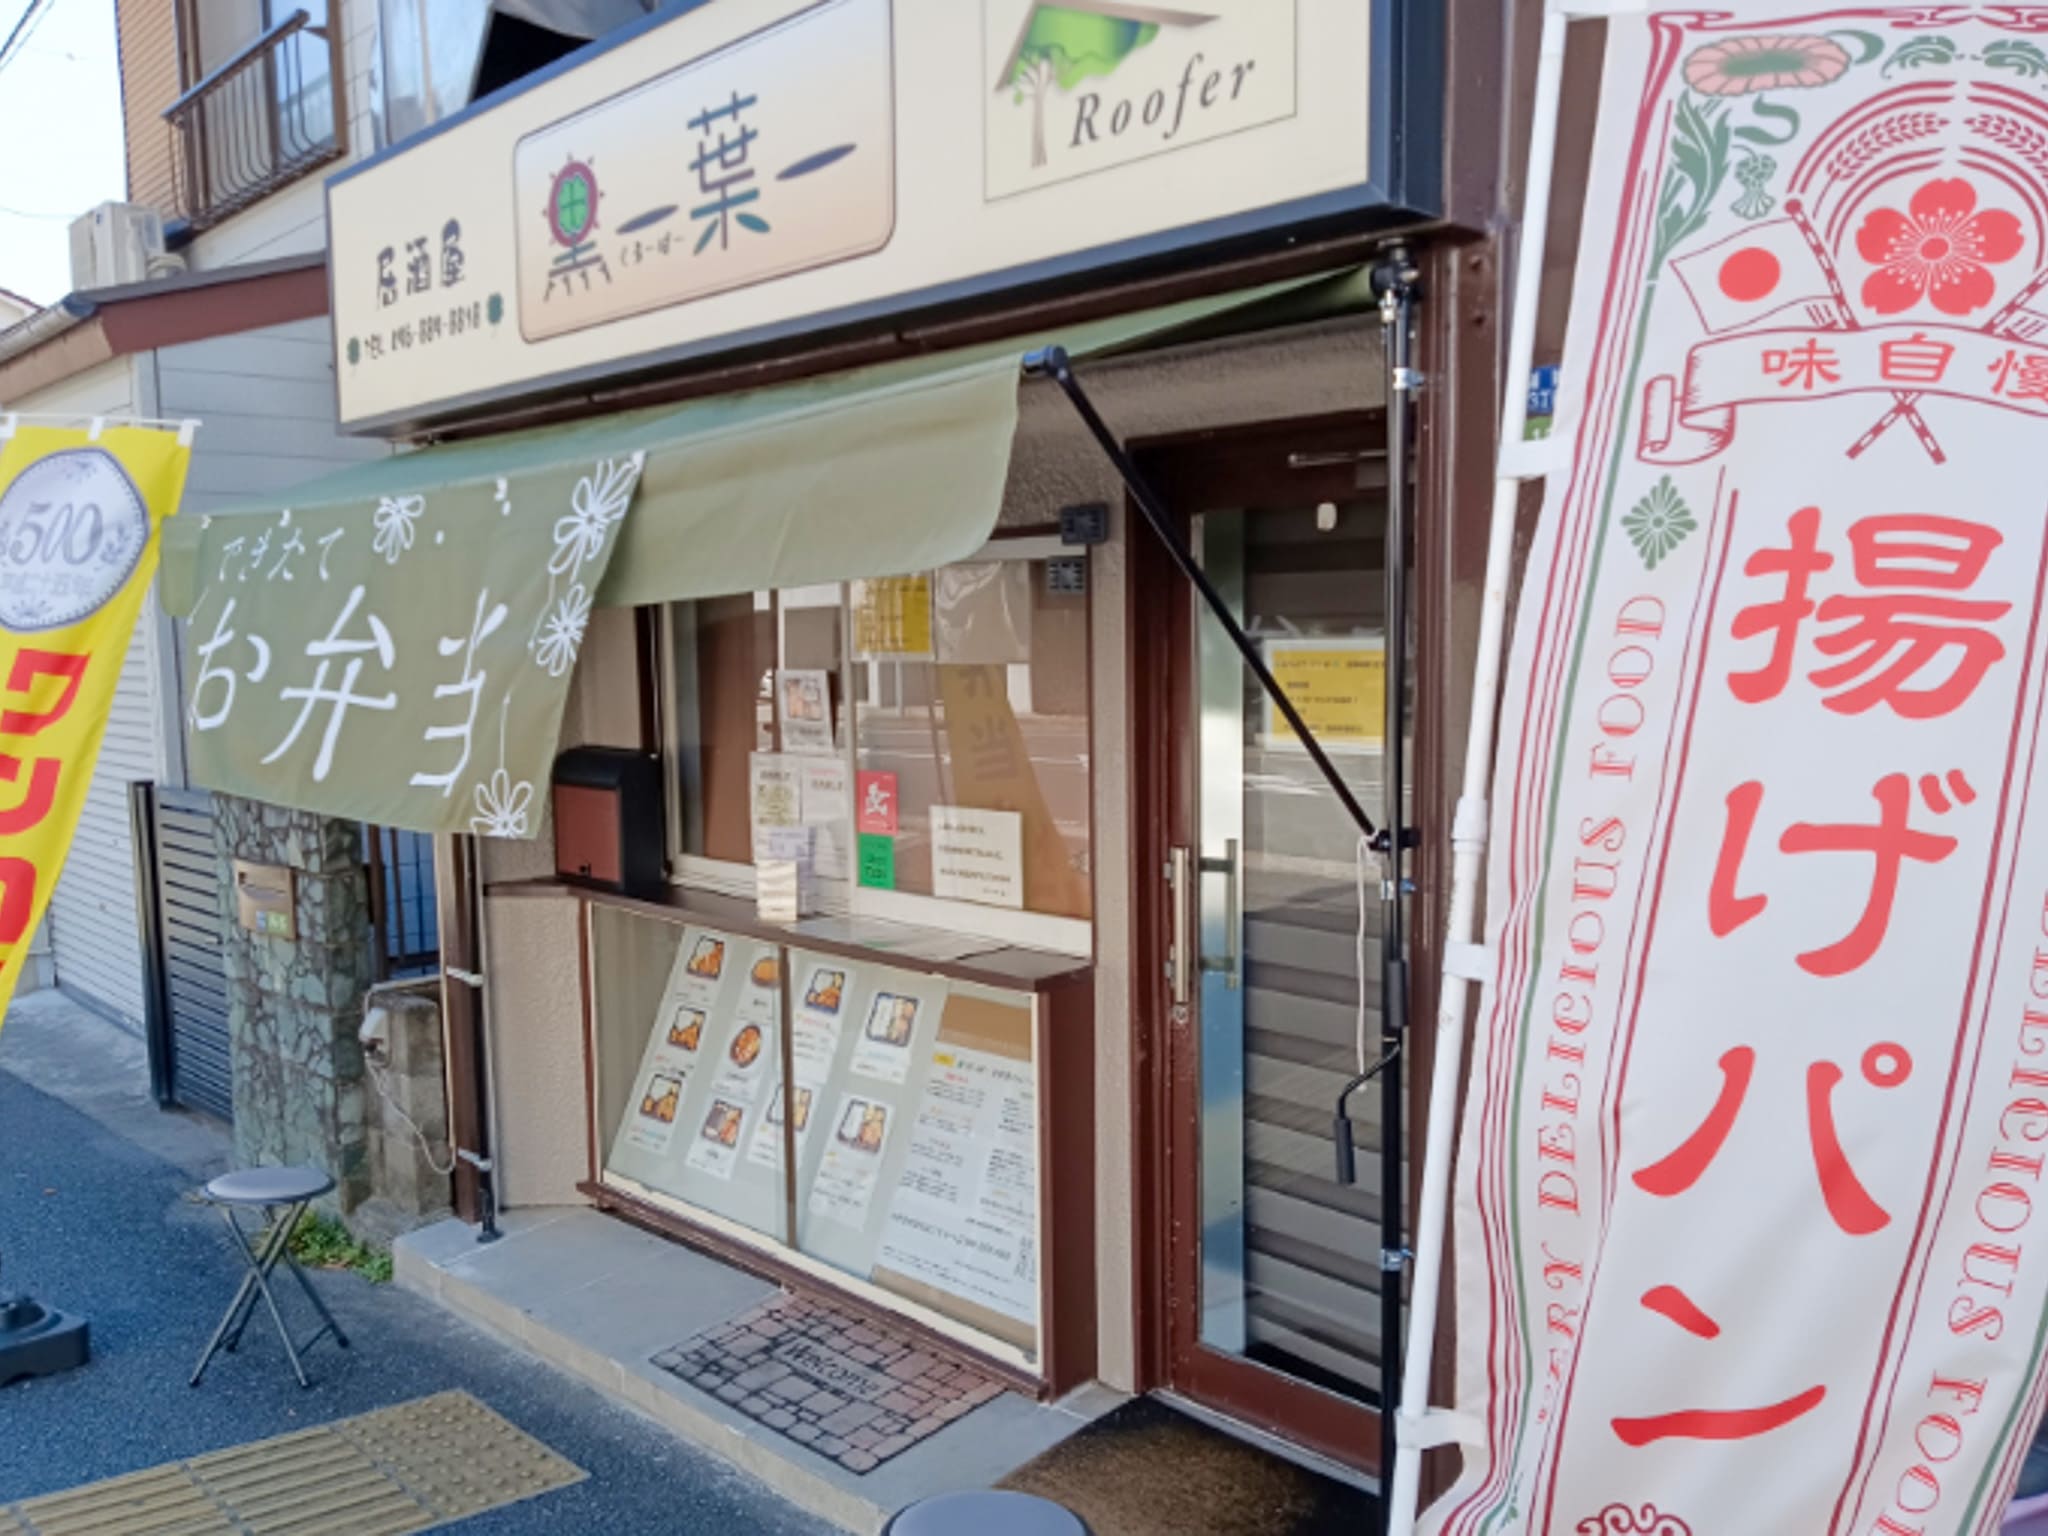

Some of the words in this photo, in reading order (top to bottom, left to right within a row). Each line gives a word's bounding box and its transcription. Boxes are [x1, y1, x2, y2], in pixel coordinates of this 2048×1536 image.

[1069, 53, 1256, 148] Roofer
[375, 218, 465, 310] 居酒屋
[1761, 332, 2048, 398] 味自慢
[8, 502, 104, 567] 500
[187, 585, 508, 798] お弁当
[1588, 594, 1666, 782] FOOD
[1536, 816, 1627, 1217] DELICIOUS
[1610, 506, 2013, 1448] 揚げパン
[1535, 1243, 1585, 1426] ERY
